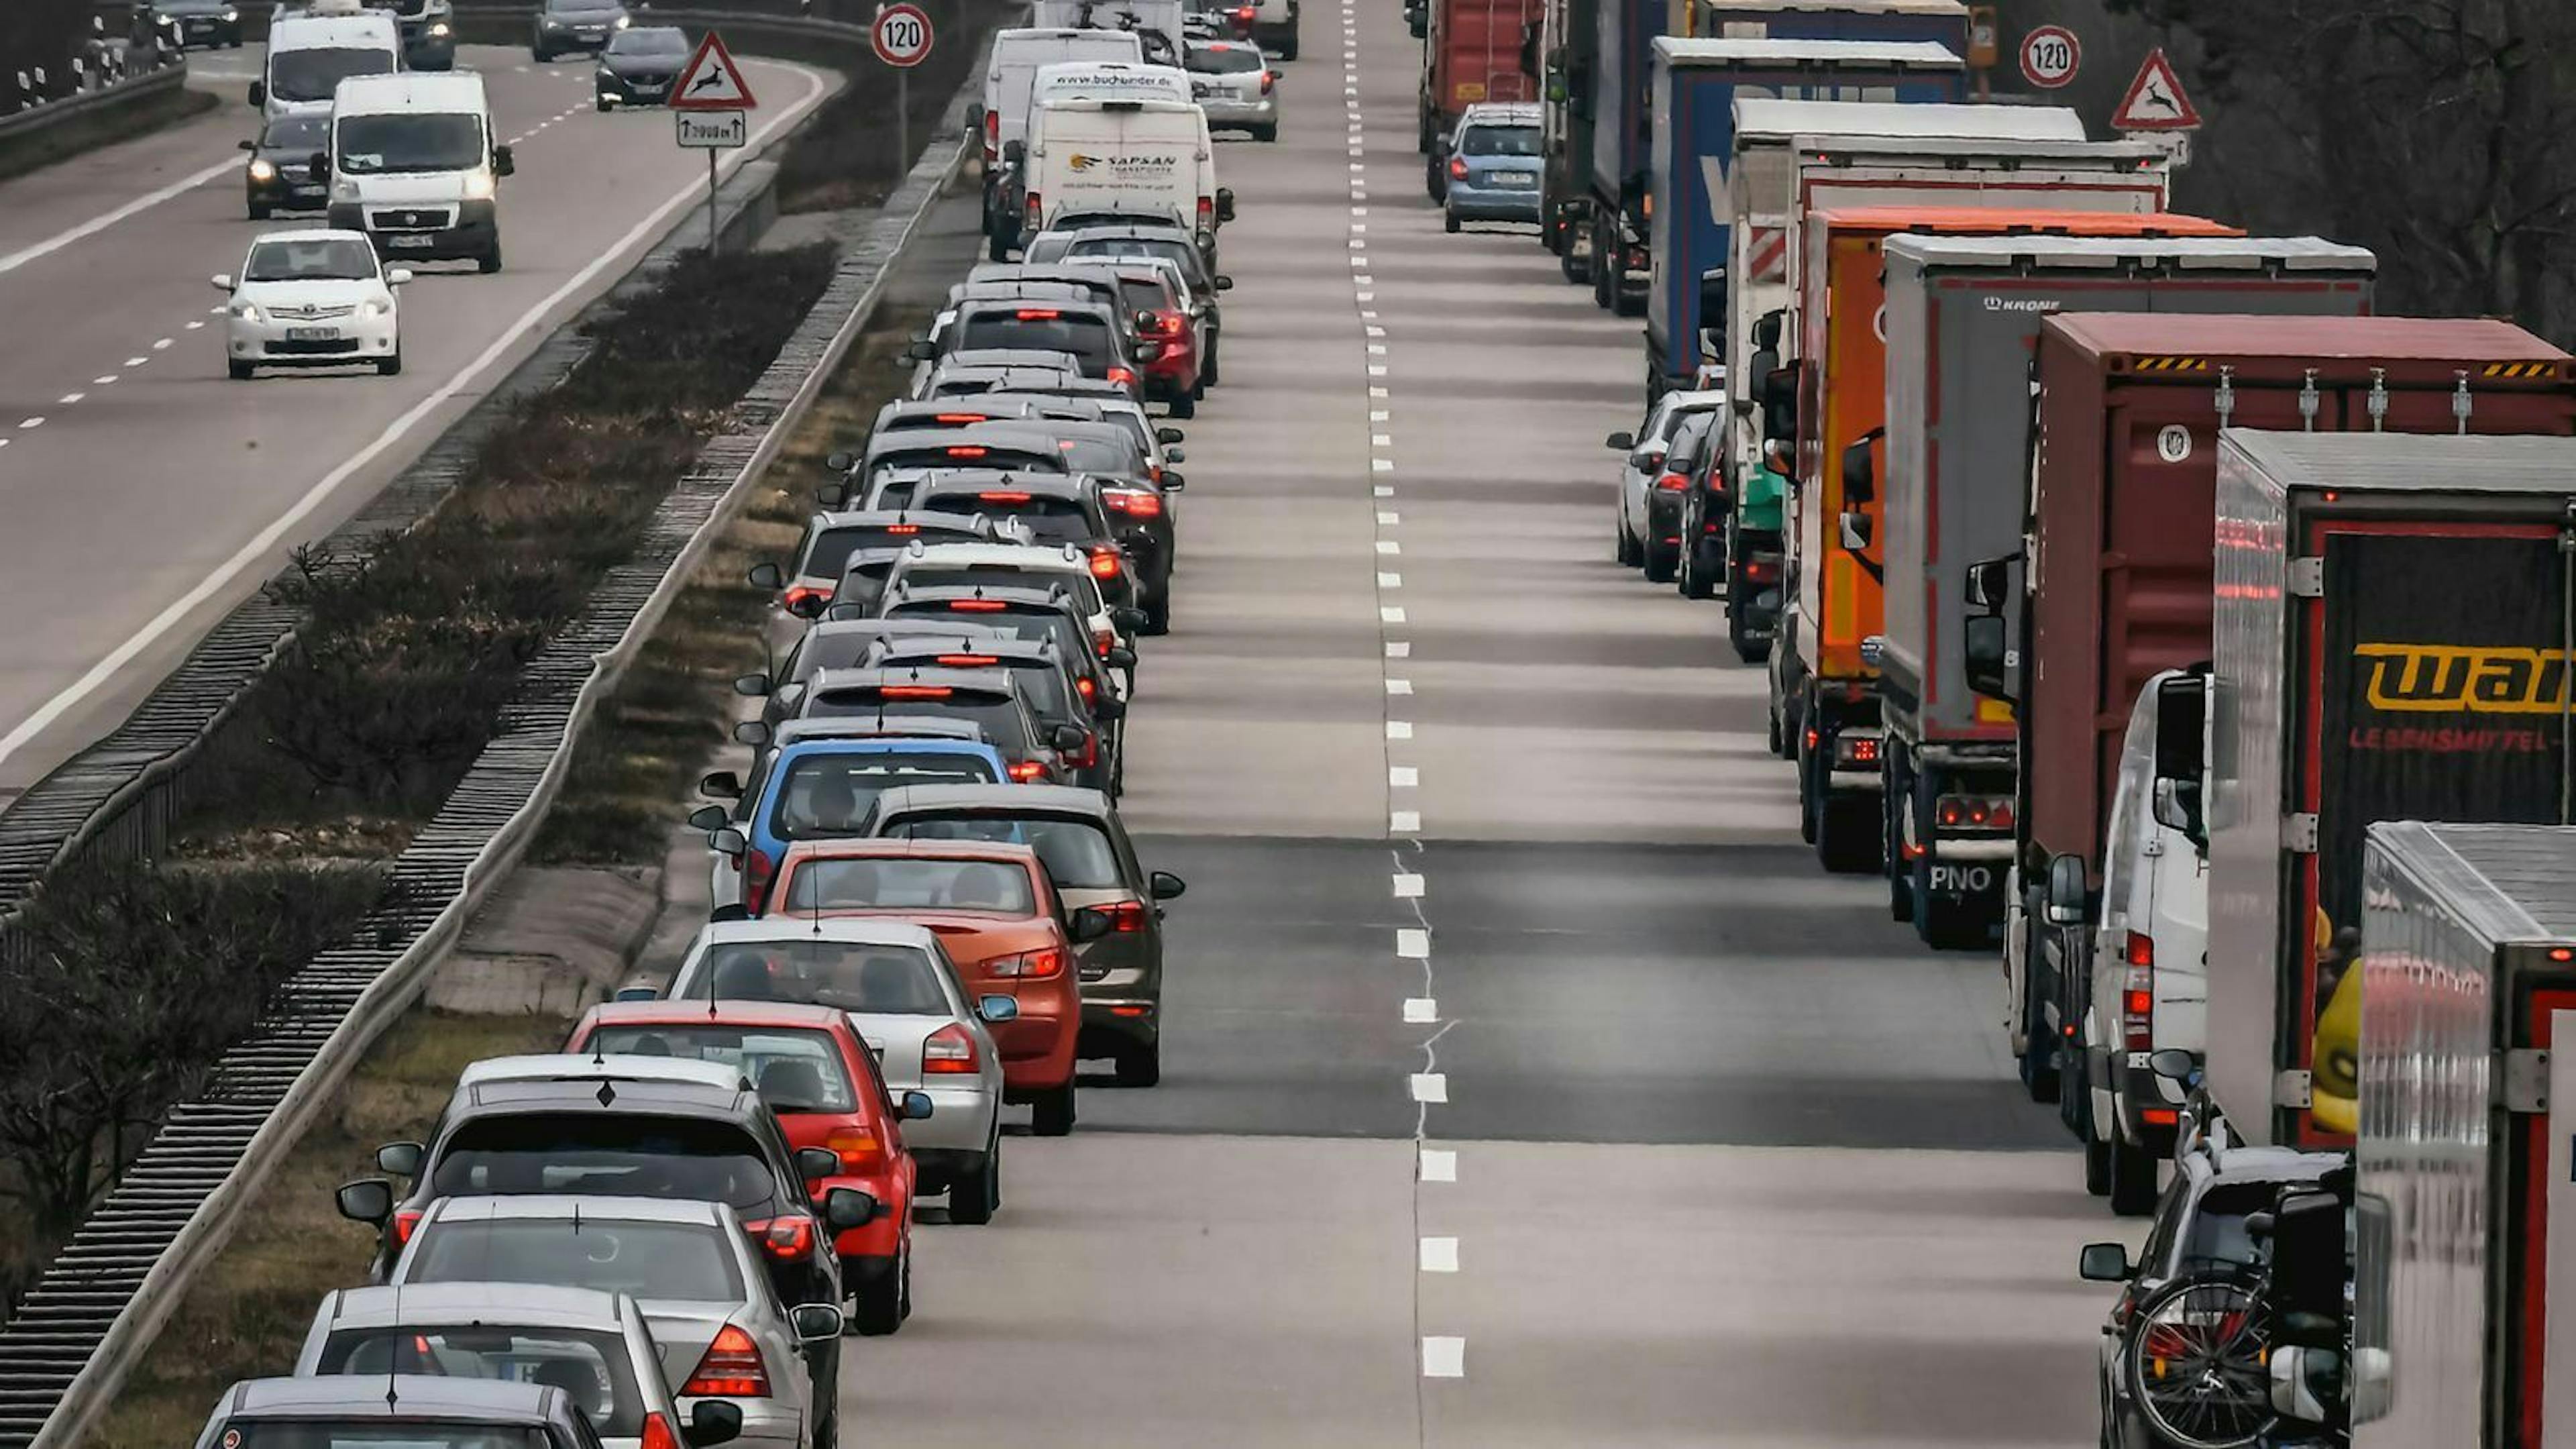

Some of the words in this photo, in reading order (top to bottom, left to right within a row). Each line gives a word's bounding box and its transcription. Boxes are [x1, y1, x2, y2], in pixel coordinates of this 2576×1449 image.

[885, 21, 919, 47] 120
[2033, 43, 2068, 69] 120
[1929, 865, 1992, 892] PNO
